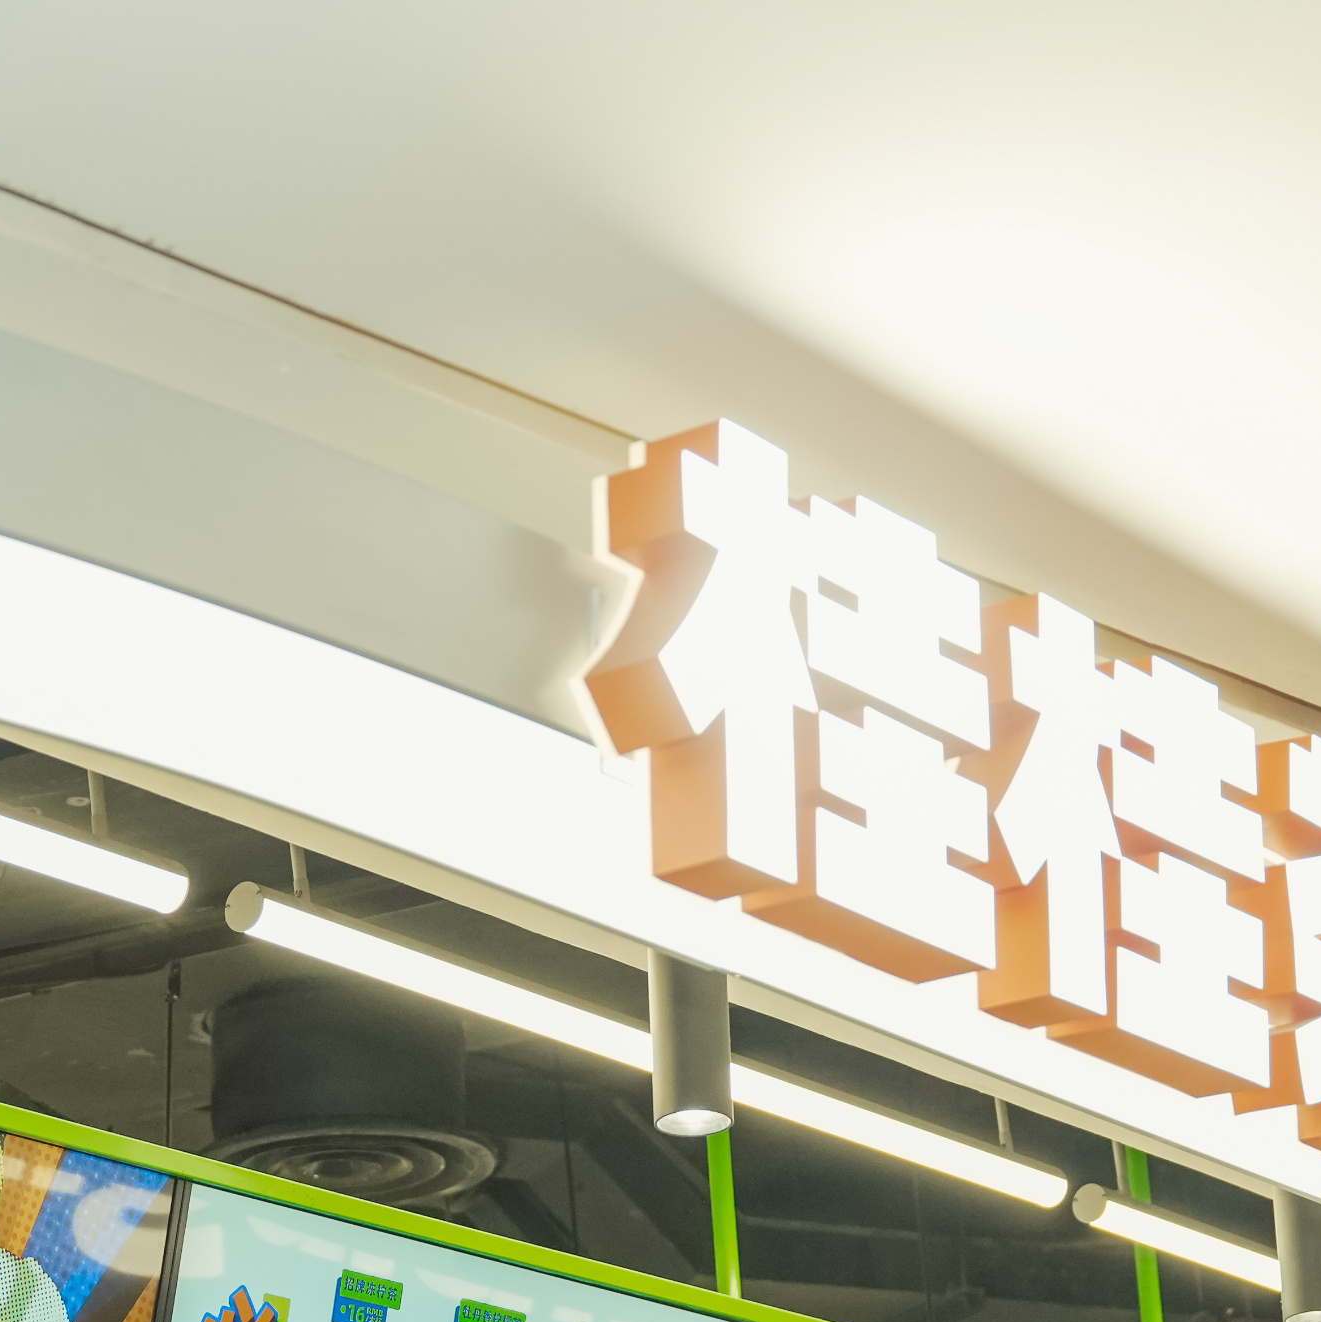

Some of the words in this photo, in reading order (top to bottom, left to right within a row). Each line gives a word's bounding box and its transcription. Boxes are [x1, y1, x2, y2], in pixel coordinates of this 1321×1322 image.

[344, 1276, 398, 1301] 招牌冻柠茶
[366, 1307, 384, 1317] RMB
